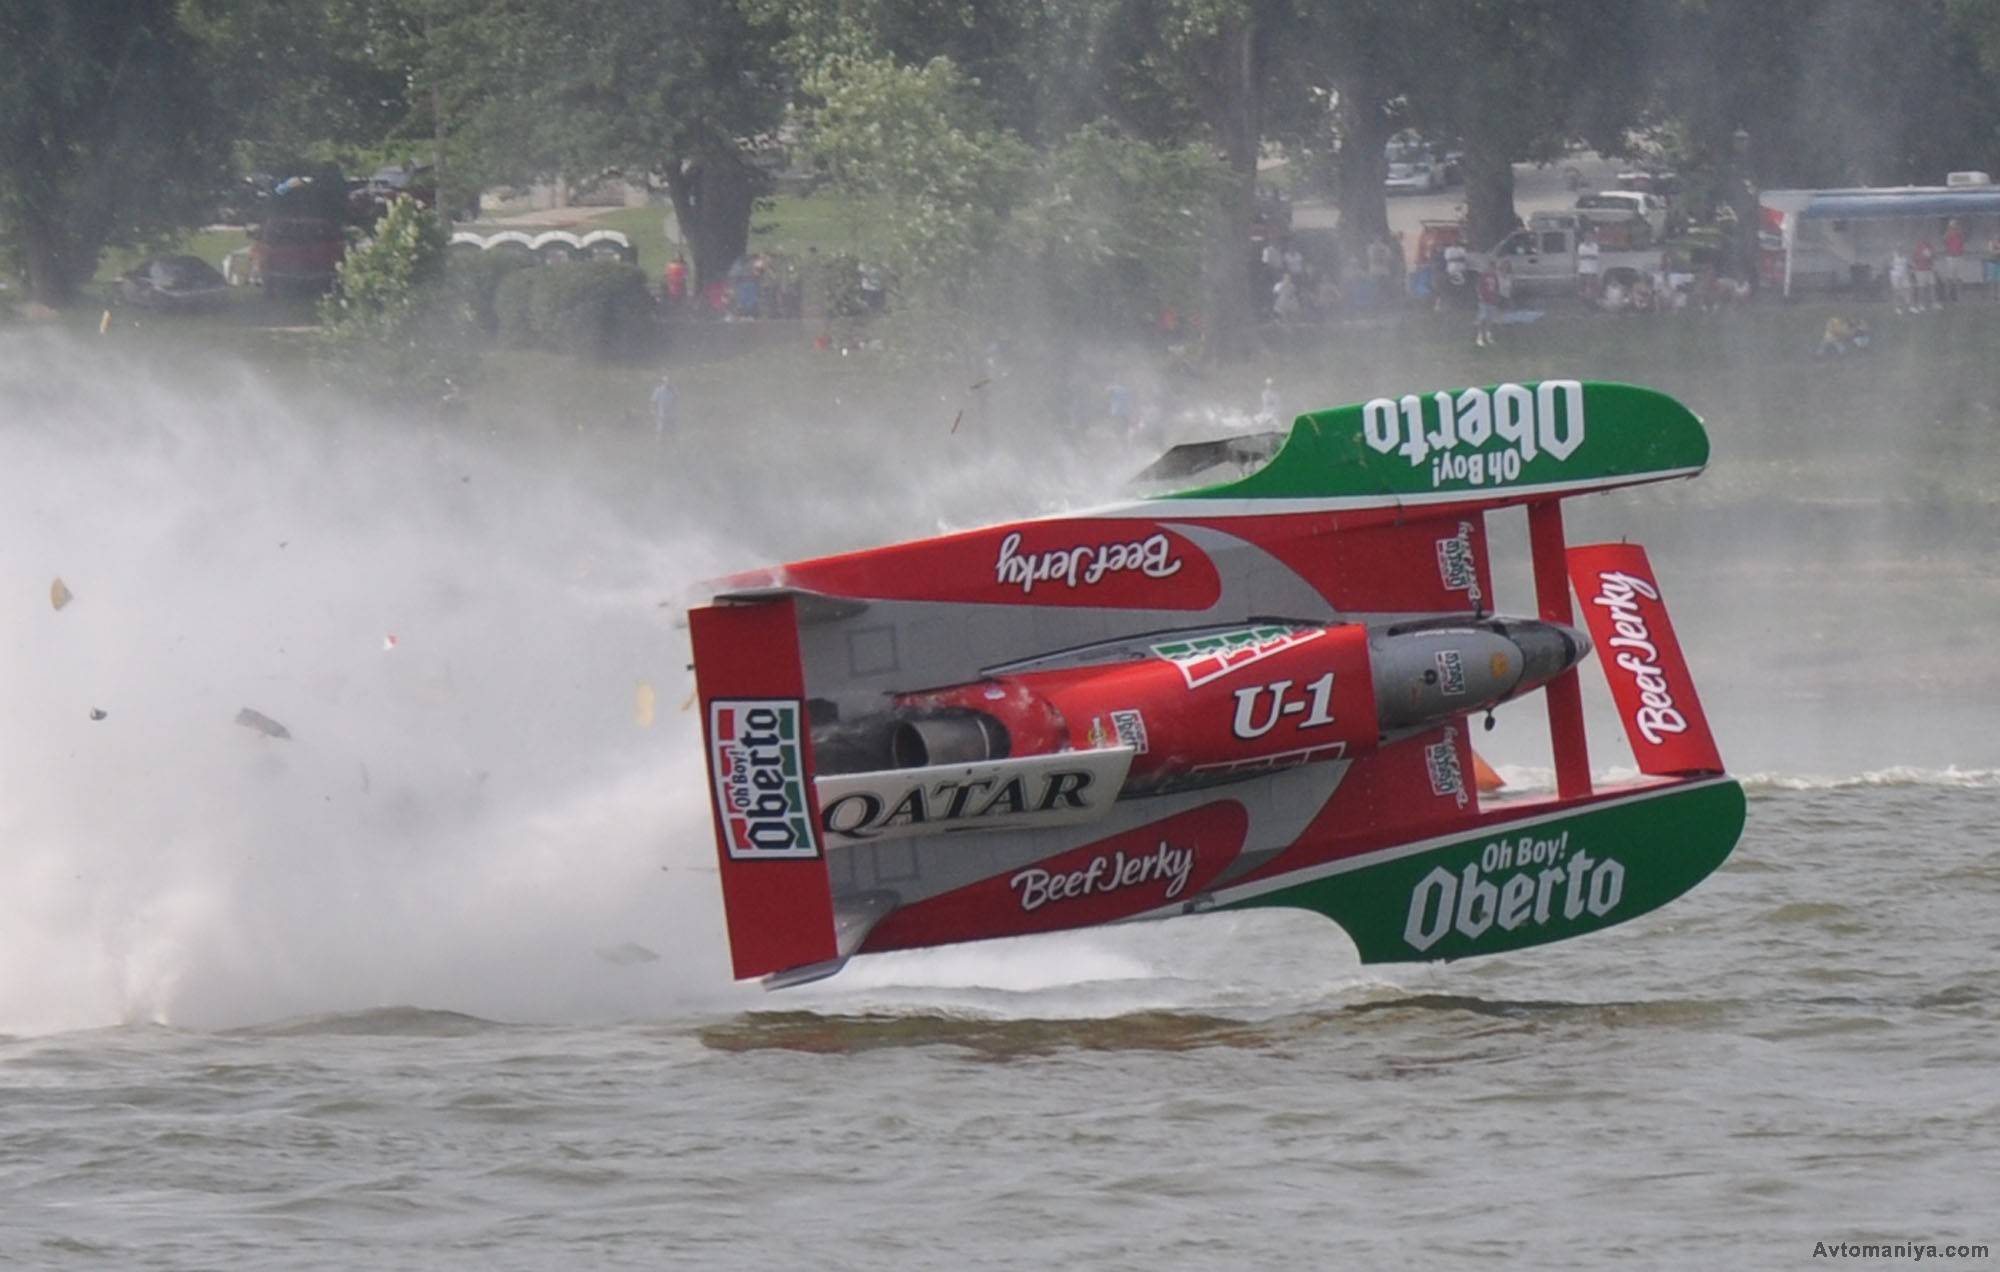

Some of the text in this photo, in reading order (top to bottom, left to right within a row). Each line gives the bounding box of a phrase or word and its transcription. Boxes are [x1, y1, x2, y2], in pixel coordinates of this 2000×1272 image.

[1363, 380, 1585, 467] Oberto
[1432, 448, 1520, 488] Oh Boy!
[995, 533, 1094, 592] Jerky
[1594, 571, 1658, 662] Jerky
[1233, 672, 1335, 739] U-1
[730, 751, 750, 807] Oh Boy!
[740, 708, 796, 849] Oberto
[820, 770, 1094, 839] QATAR
[1099, 841, 1193, 898] Jerky
[1482, 831, 1568, 873] Oh Boy!
[1403, 849, 1625, 952] Oberto
